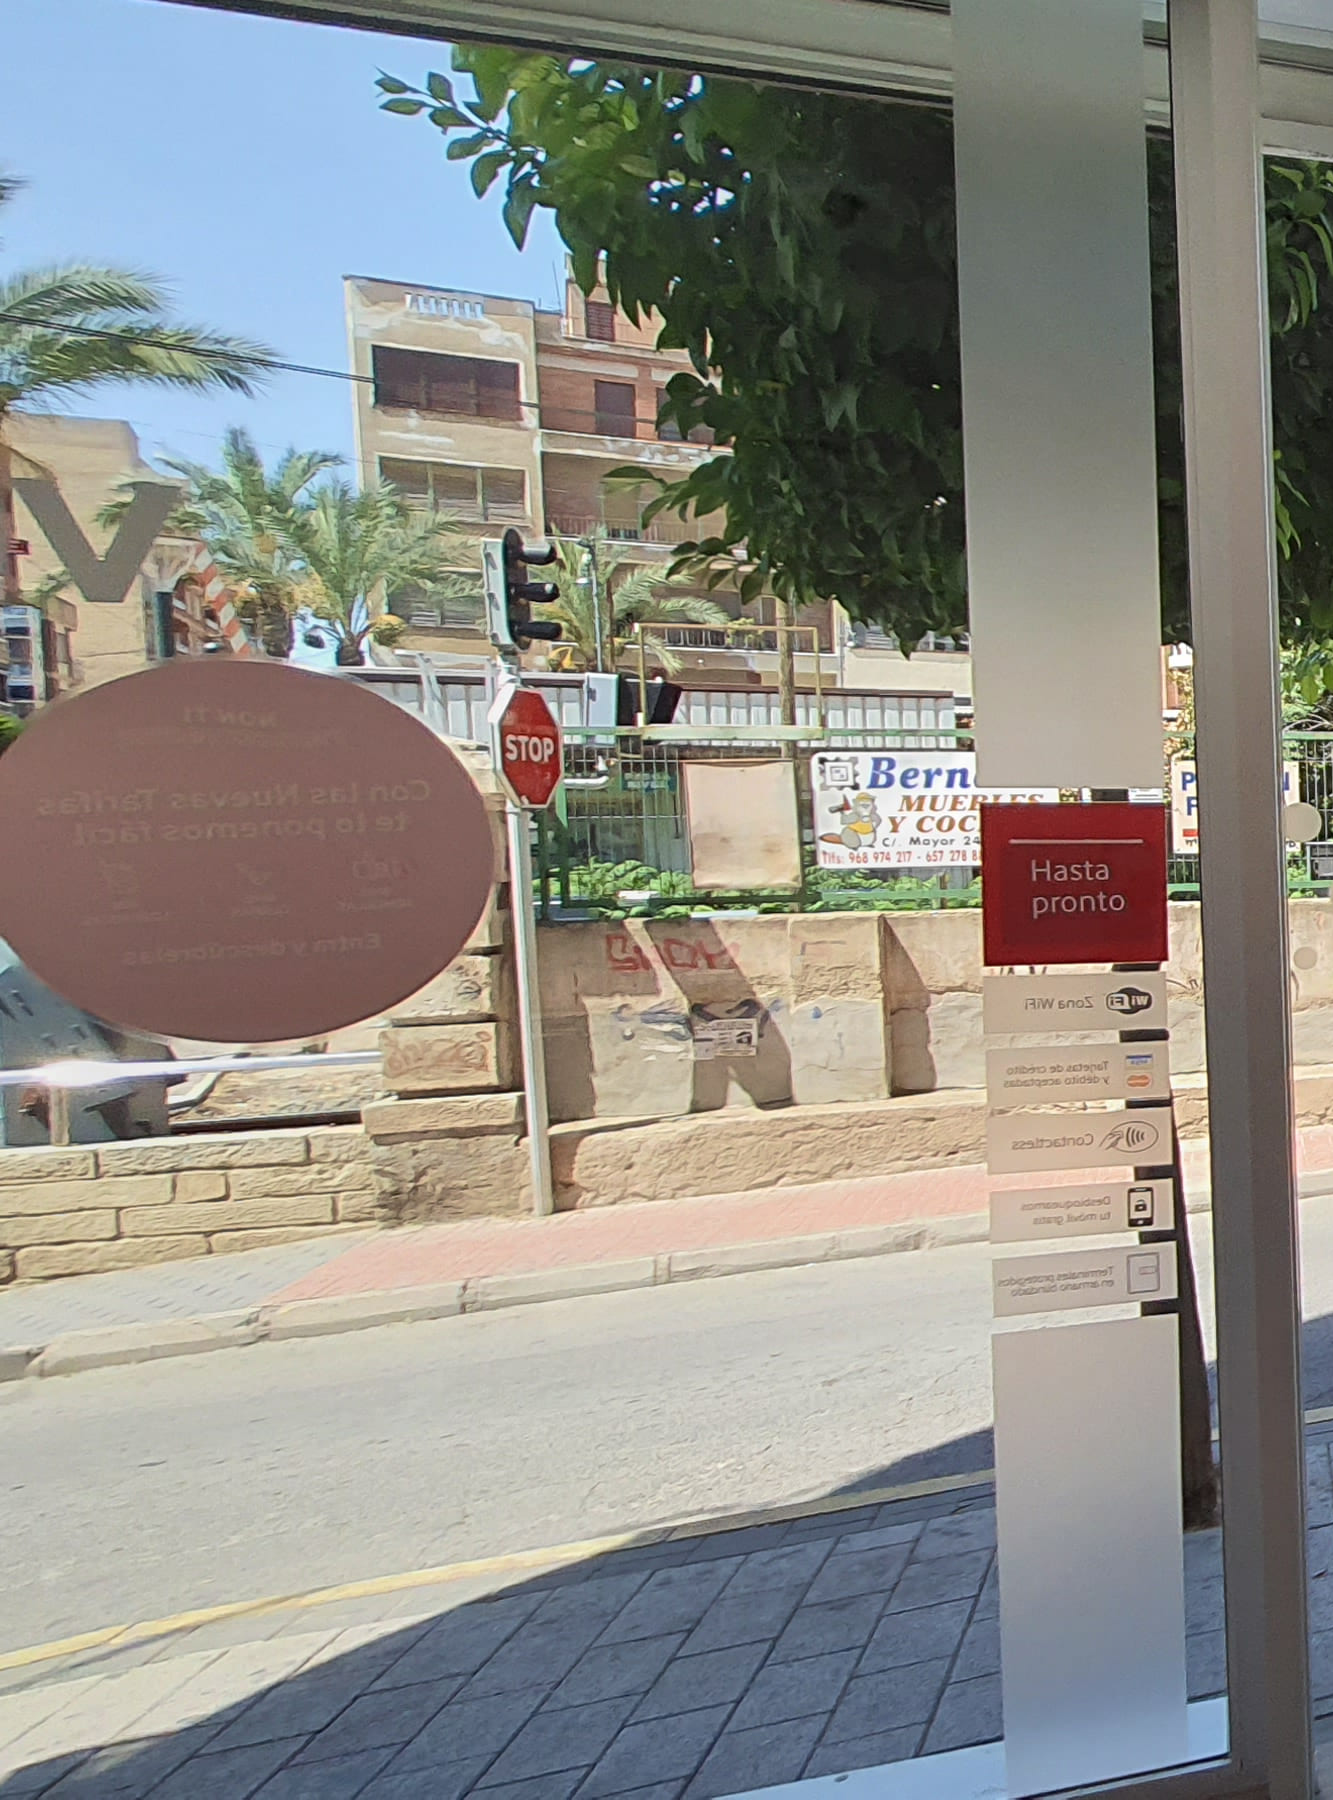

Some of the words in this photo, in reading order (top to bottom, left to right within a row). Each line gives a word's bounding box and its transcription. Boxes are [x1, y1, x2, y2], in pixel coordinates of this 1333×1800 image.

[505, 734, 554, 764] STOP
[867, 757, 976, 790] Bern
[888, 815, 908, 833] Y
[916, 815, 981, 834] COC
[910, 836, 955, 849] Mayor
[849, 851, 869, 865] 968
[873, 850, 892, 864] 974
[896, 850, 913, 863] 217
[926, 849, 944, 863] 657
[950, 849, 967, 862] 278
[1031, 859, 1110, 883] Hasta
[1032, 889, 1125, 920] pronto
